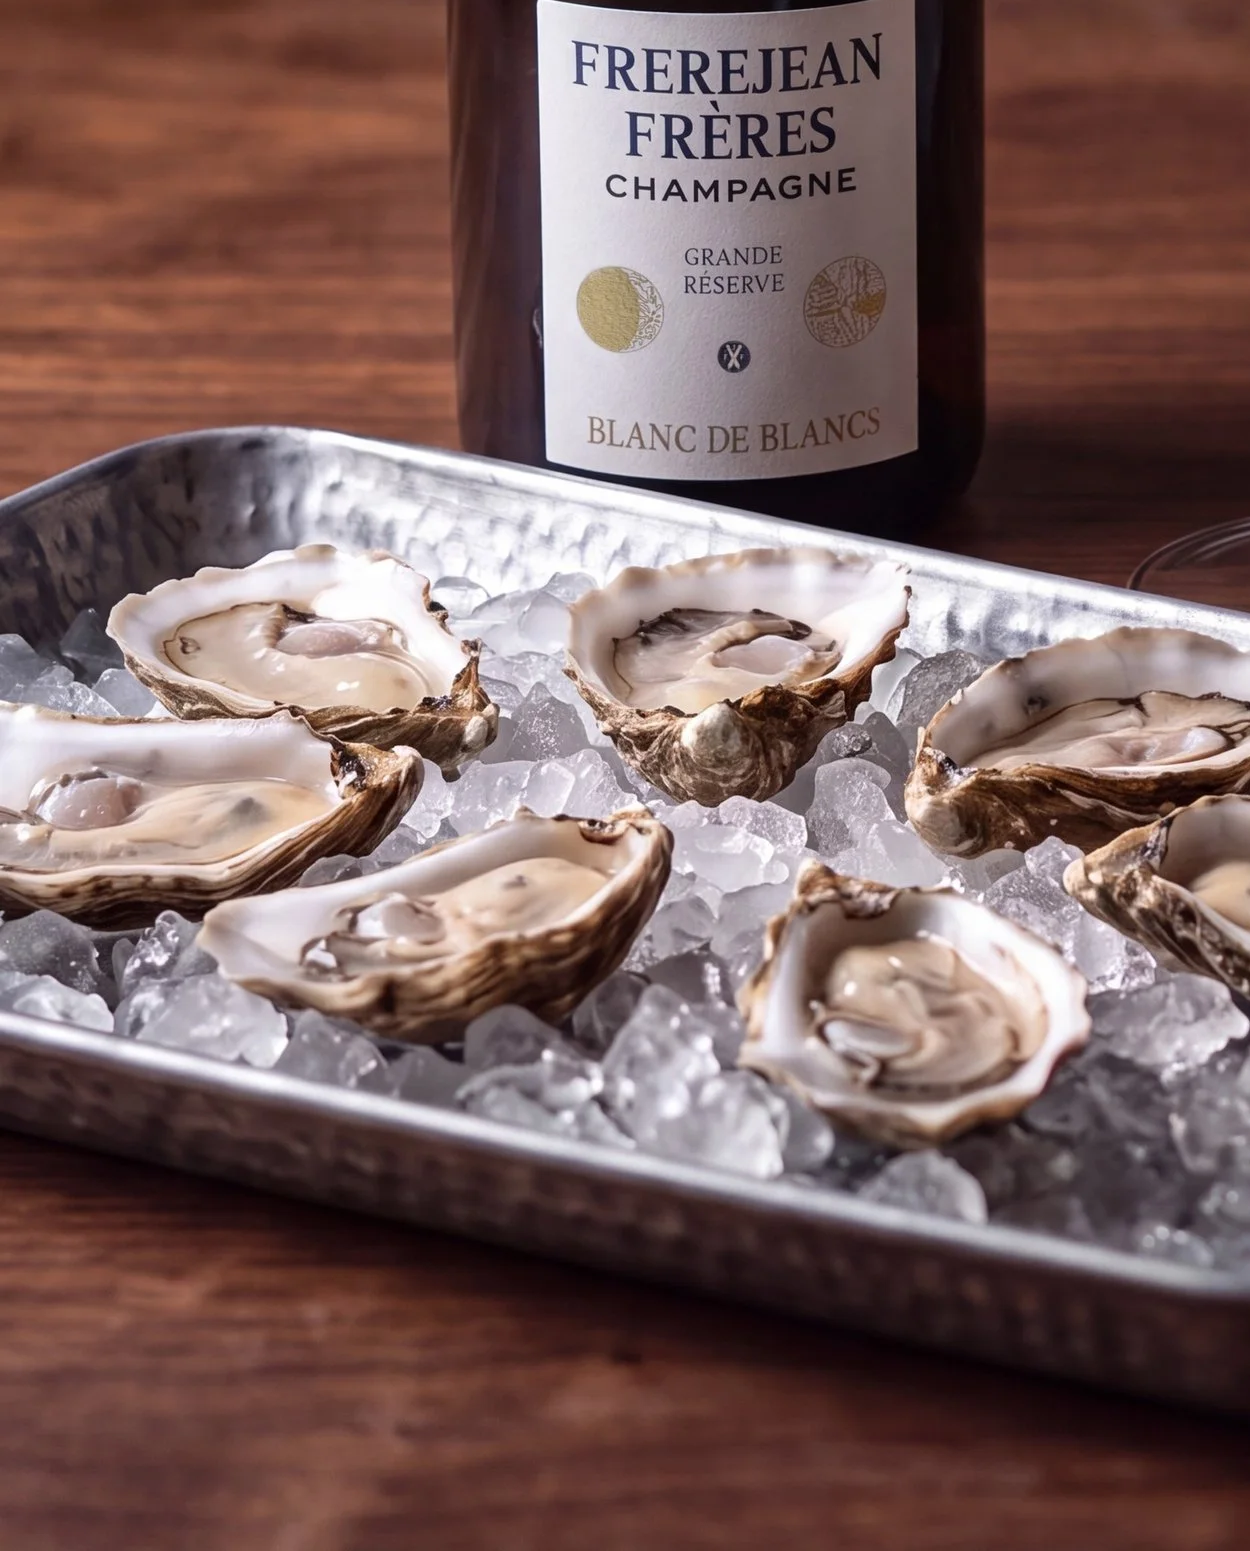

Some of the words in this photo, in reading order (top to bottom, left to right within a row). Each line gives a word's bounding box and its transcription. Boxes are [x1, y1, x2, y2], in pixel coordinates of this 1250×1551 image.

[572, 32, 883, 95] FREREJEAN
[624, 100, 837, 160] FRÈRES
[605, 167, 857, 203] CHAMPAGNE
[684, 245, 783, 267] GRANDE
[684, 269, 785, 295] RÉSERVE
[587, 415, 697, 453] BLANC
[707, 426, 750, 454] DE
[759, 407, 881, 453] BLANCS
